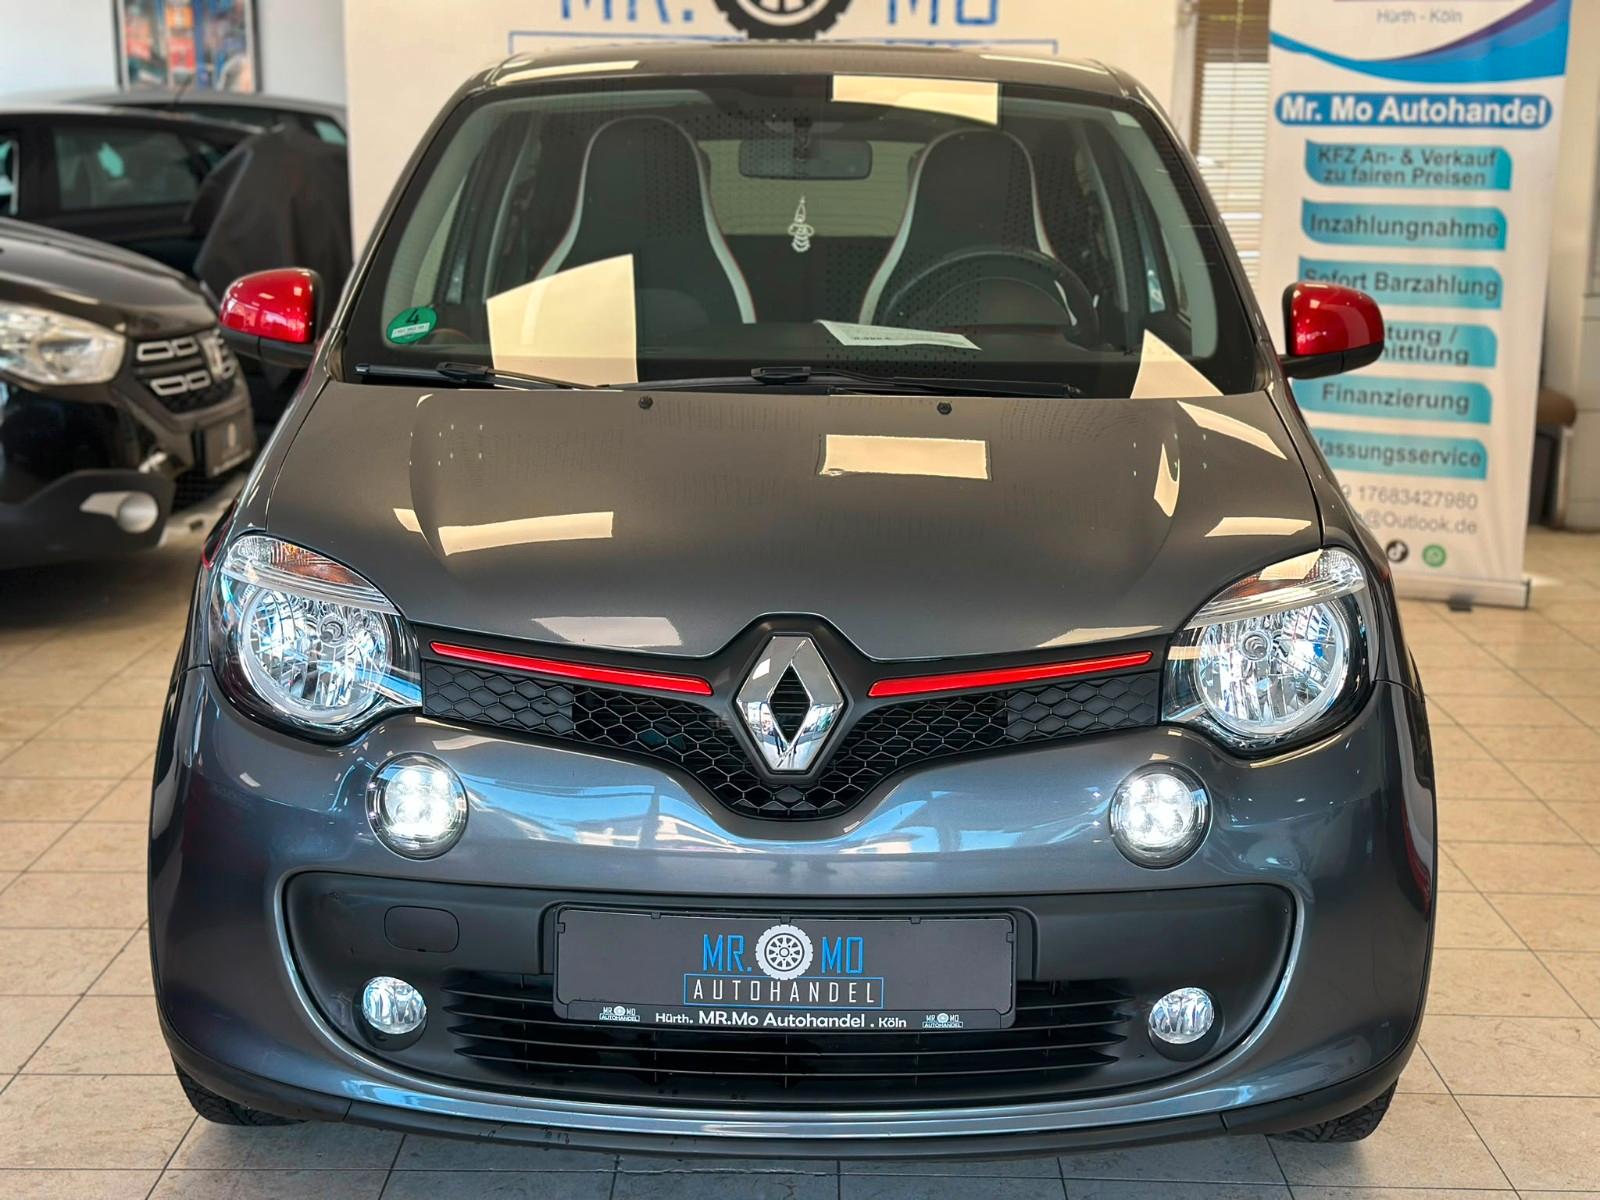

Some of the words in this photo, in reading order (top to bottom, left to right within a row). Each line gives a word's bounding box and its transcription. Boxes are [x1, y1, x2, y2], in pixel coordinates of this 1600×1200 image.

[1377, 9, 1416, 23] Hürth
[1430, 9, 1463, 23] Köln
[1281, 96, 1322, 121] Mr.
[1331, 97, 1373, 122] Mo
[1379, 96, 1546, 124] Autohandel
[1317, 148, 1355, 164] KFZ
[1361, 149, 1395, 164] An-
[1400, 150, 1413, 165] &
[1421, 149, 1497, 167] Verkauf
[1324, 170, 1346, 183] zu
[1352, 167, 1405, 184] fairen
[1412, 168, 1486, 186] Preisen
[1310, 213, 1499, 241] Inzahlungnahme
[1374, 271, 1498, 300] Barzahlung
[405, 309, 419, 324] 4
[1387, 326, 1441, 347] tung
[1449, 325, 1458, 344] /
[1384, 343, 1469, 367] ittlung
[1322, 383, 1470, 416] Finanzierung
[1319, 438, 1481, 467] lassungsservice
[703, 934, 752, 972] MR.
[822, 936, 864, 974] MO
[693, 979, 875, 1003] AUTOHANDEL
[655, 1012, 694, 1024] Hürth.
[699, 1011, 759, 1026] MR.Mo
[763, 1011, 865, 1028] Autohandel
[879, 1017, 907, 1028] Köln
